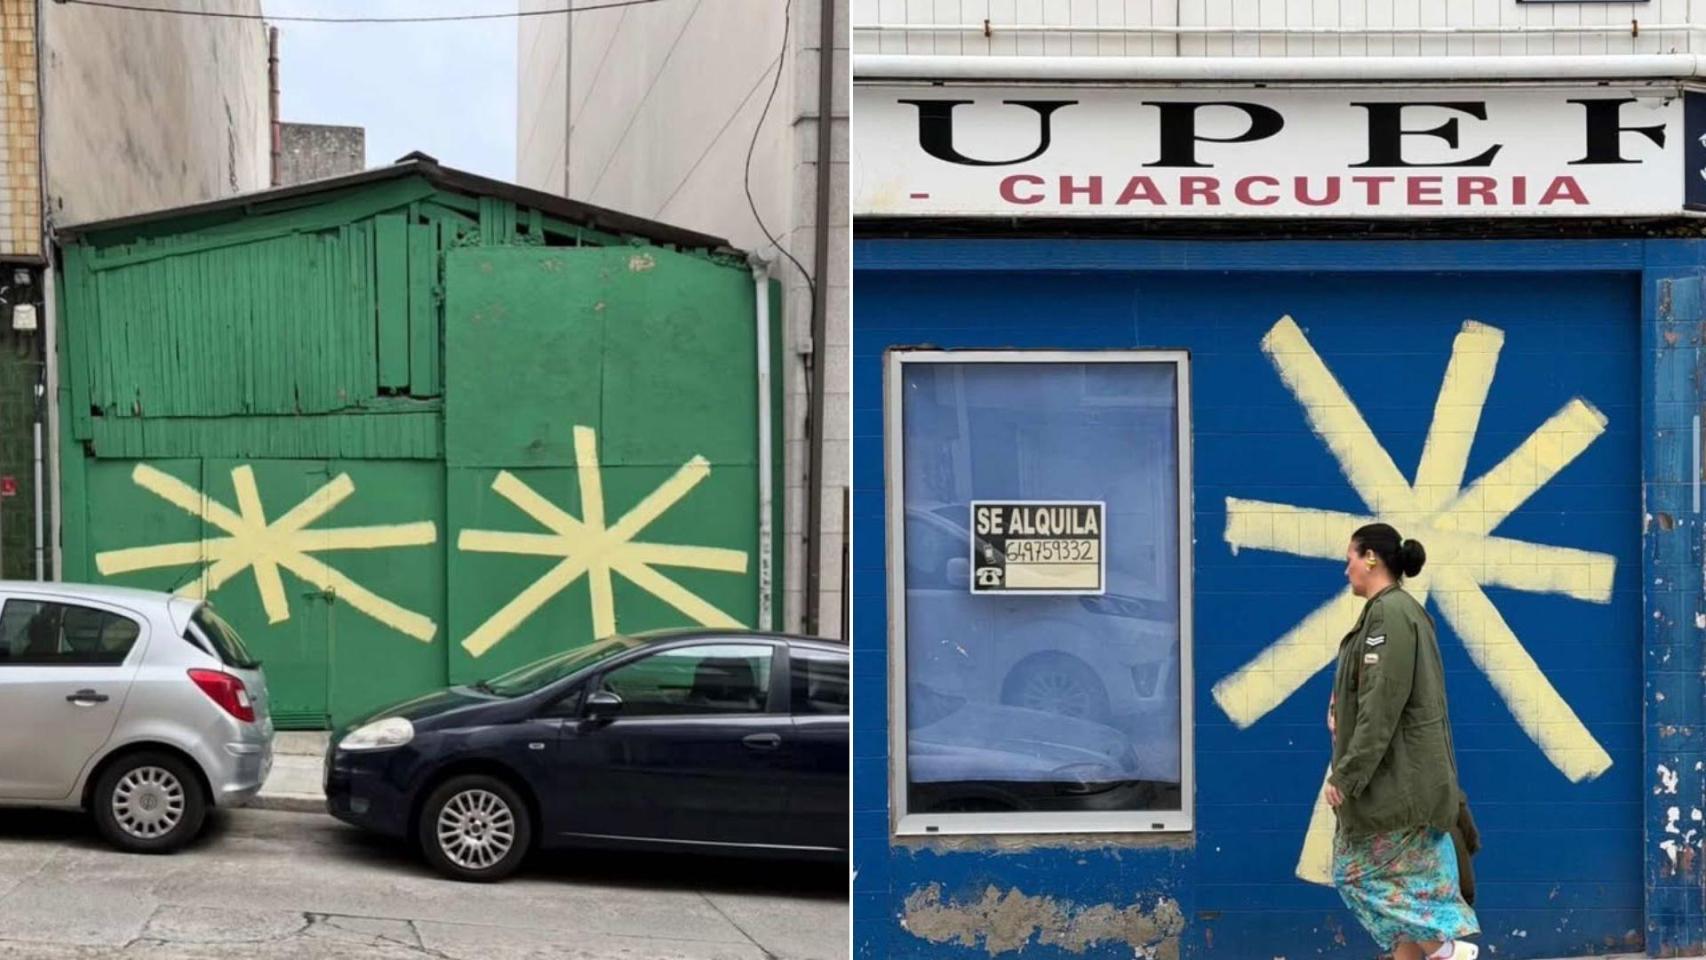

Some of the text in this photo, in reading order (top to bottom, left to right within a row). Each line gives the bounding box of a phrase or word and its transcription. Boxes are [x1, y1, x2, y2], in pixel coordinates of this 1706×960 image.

[1000, 175, 1590, 206] CHARCUTERIA
[977, 507, 1099, 536] SE ALQUILA
[1006, 541, 1093, 562] 649759332
